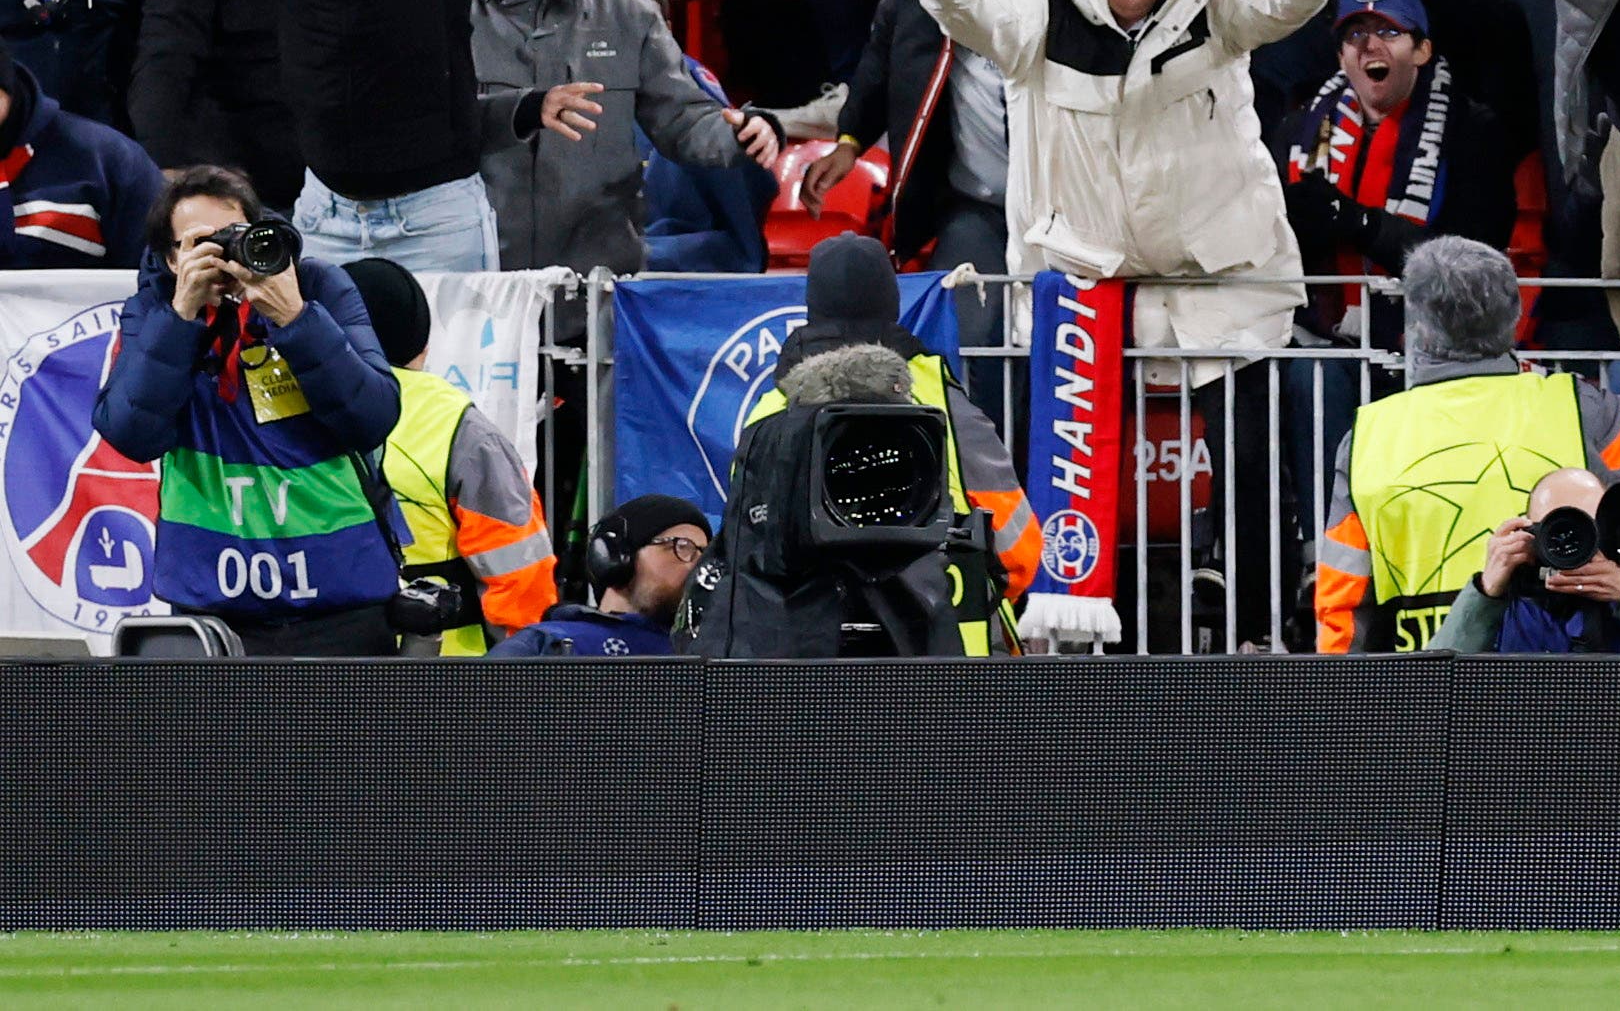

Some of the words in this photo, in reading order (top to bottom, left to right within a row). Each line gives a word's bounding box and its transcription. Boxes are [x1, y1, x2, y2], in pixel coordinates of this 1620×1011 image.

[1134, 438, 1213, 482] 25A
[224, 476, 292, 526] TV
[217, 547, 318, 600] 001
